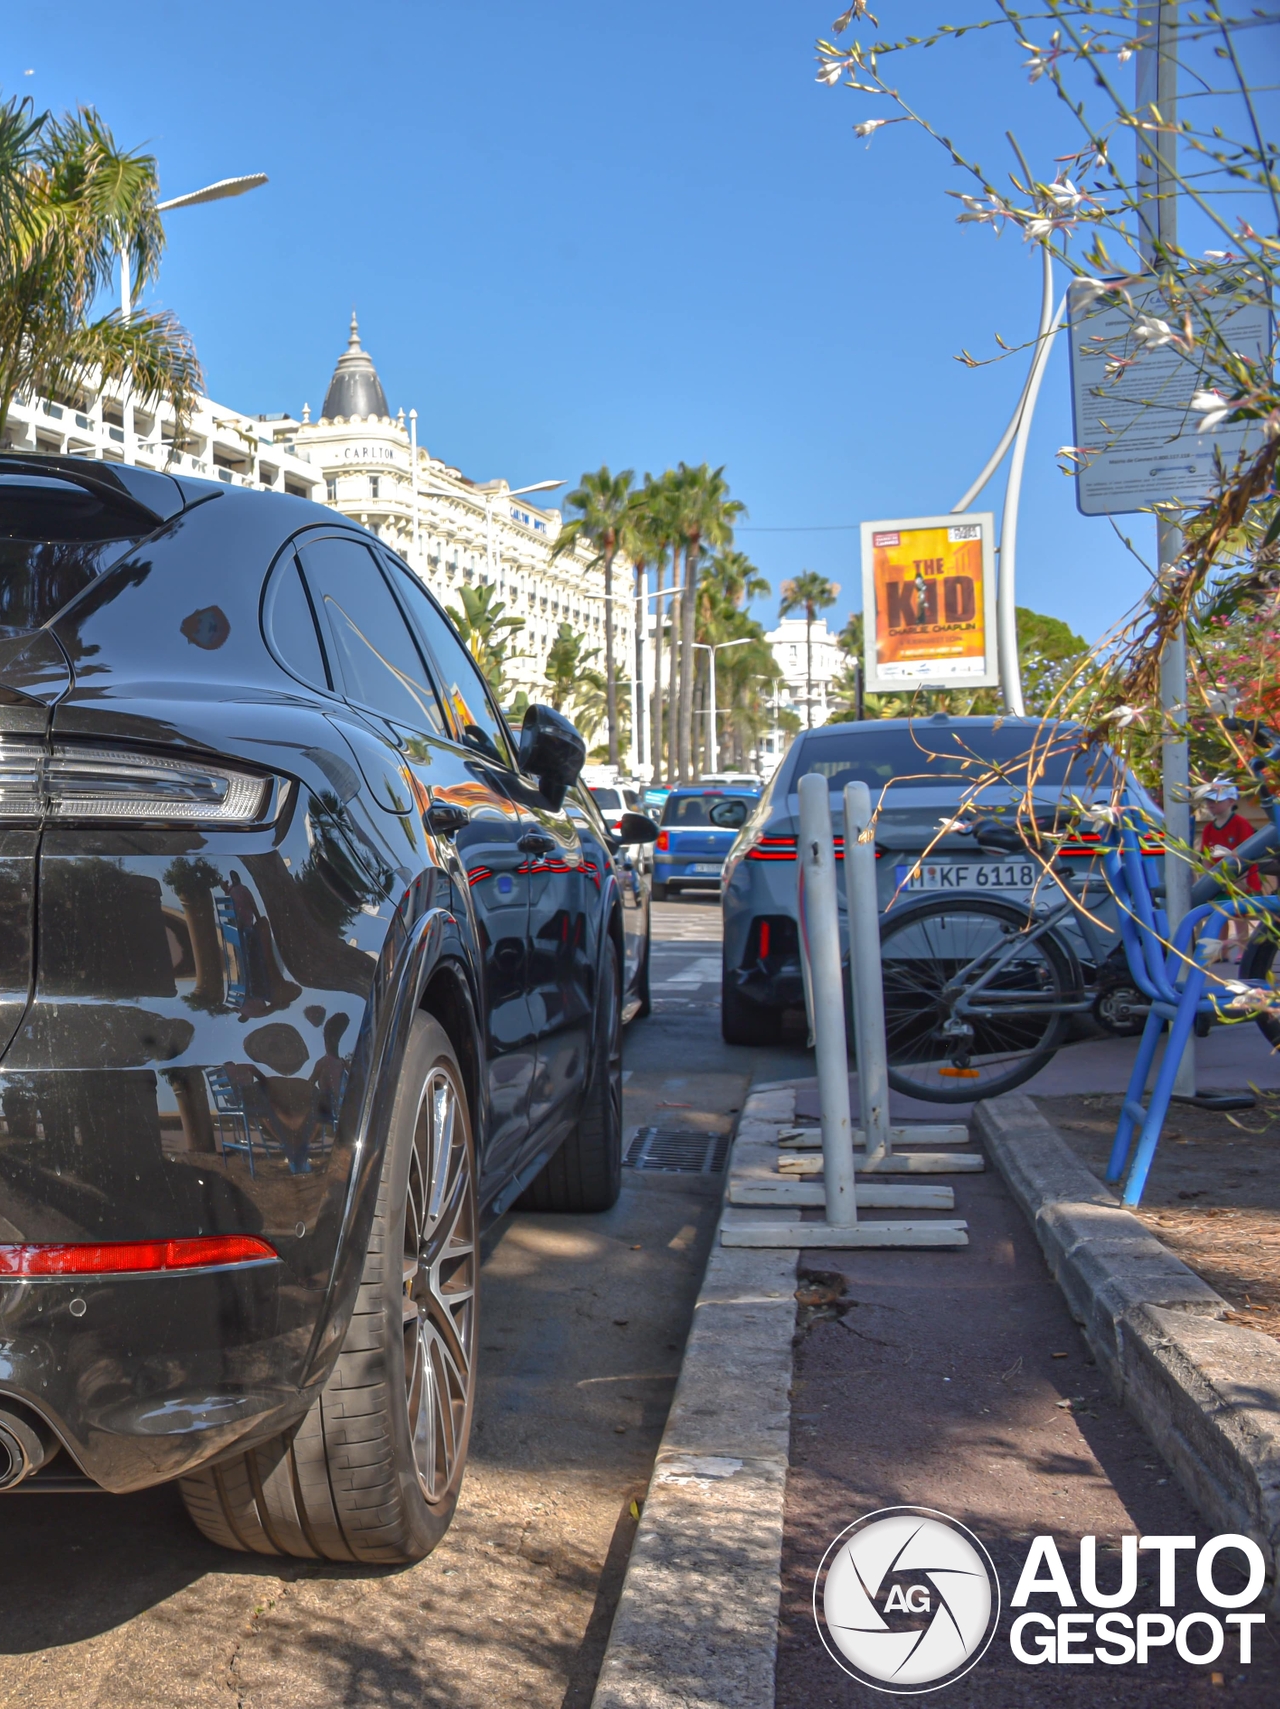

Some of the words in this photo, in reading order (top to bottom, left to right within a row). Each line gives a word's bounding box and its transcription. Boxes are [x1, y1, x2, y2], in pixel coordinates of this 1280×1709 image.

[344, 446, 394, 459] CARLTON
[913, 557, 945, 576] THE
[885, 575, 976, 629] KID
[888, 626, 929, 637] CHARLIE
[932, 623, 976, 635] CHAPLIN
[940, 866, 970, 887] KF
[976, 866, 1033, 887] 6118
